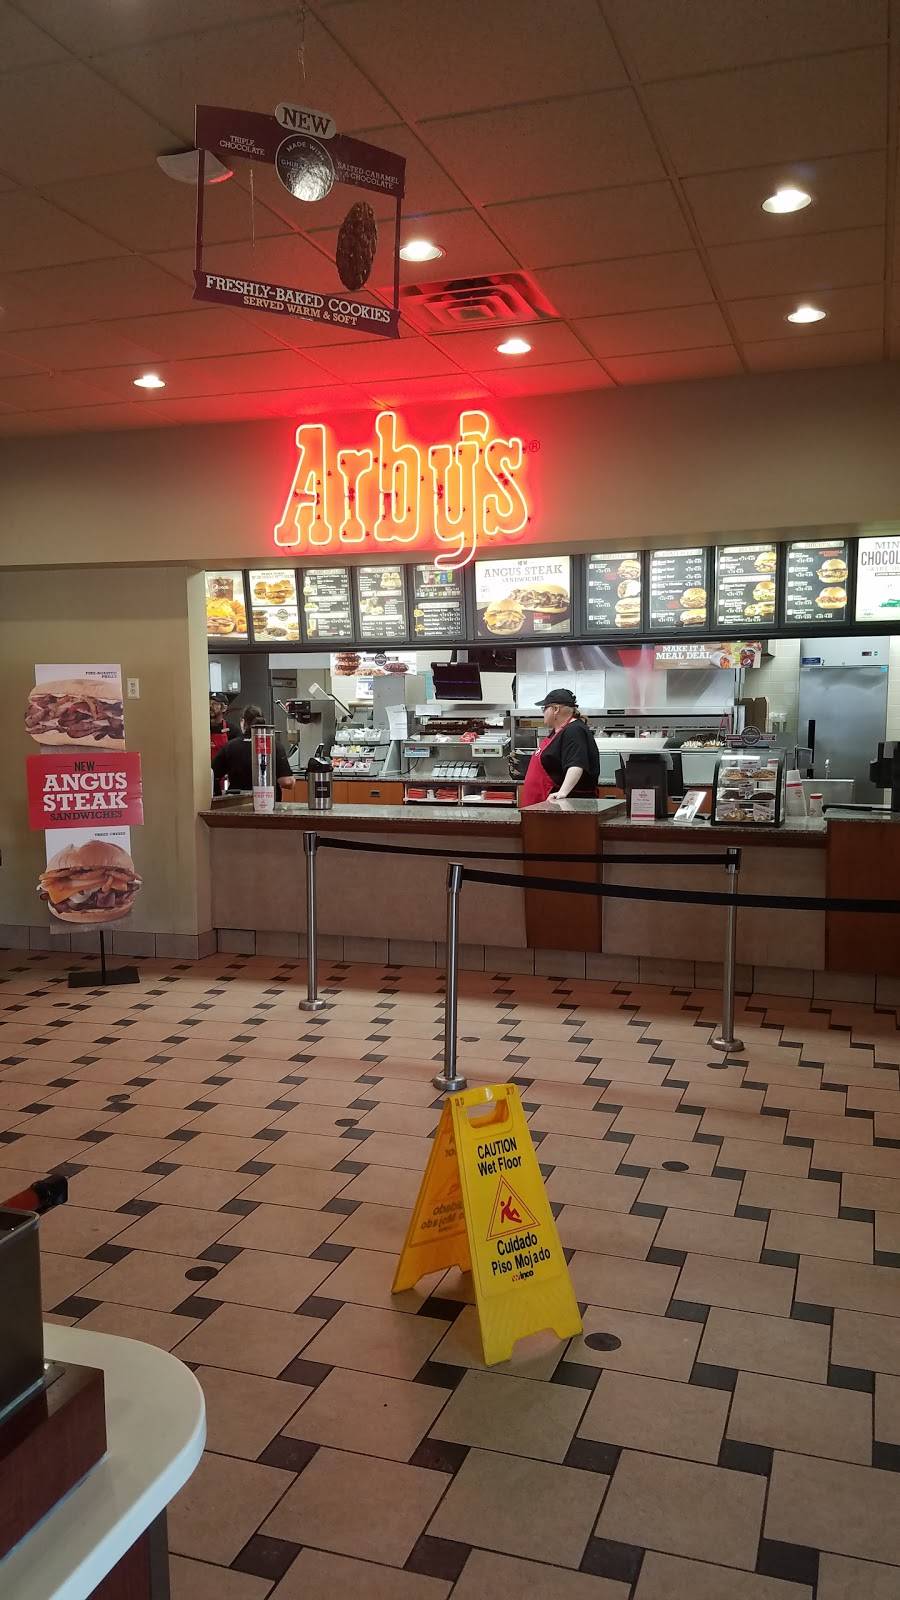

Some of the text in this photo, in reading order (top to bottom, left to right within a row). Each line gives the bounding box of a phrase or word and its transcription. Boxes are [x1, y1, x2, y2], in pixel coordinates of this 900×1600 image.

[281, 106, 332, 135] NEW
[219, 140, 265, 156] CHOCOLATE
[230, 135, 255, 147] TRIPLE
[286, 141, 307, 153] MADE
[350, 173, 394, 189] CHOCOLATE
[206, 274, 391, 323] FRESHLY-BAKED COOKIES
[243, 296, 358, 326] SERVED WARM & SOFT
[273, 410, 529, 570] Arby's
[484, 564, 563, 578] ANGUS STEAK
[656, 652, 712, 660] MEAL DEAL
[74, 761, 95, 772] NEW
[43, 772, 128, 792] ANGUS
[43, 791, 128, 812] STEAK
[50, 811, 122, 821] SANDWICHES
[477, 1137, 518, 1159] CAUTION
[478, 1156, 522, 1176] Wet Floor
[497, 1232, 538, 1256] Cuidado
[491, 1247, 551, 1276] Piso Mojado
